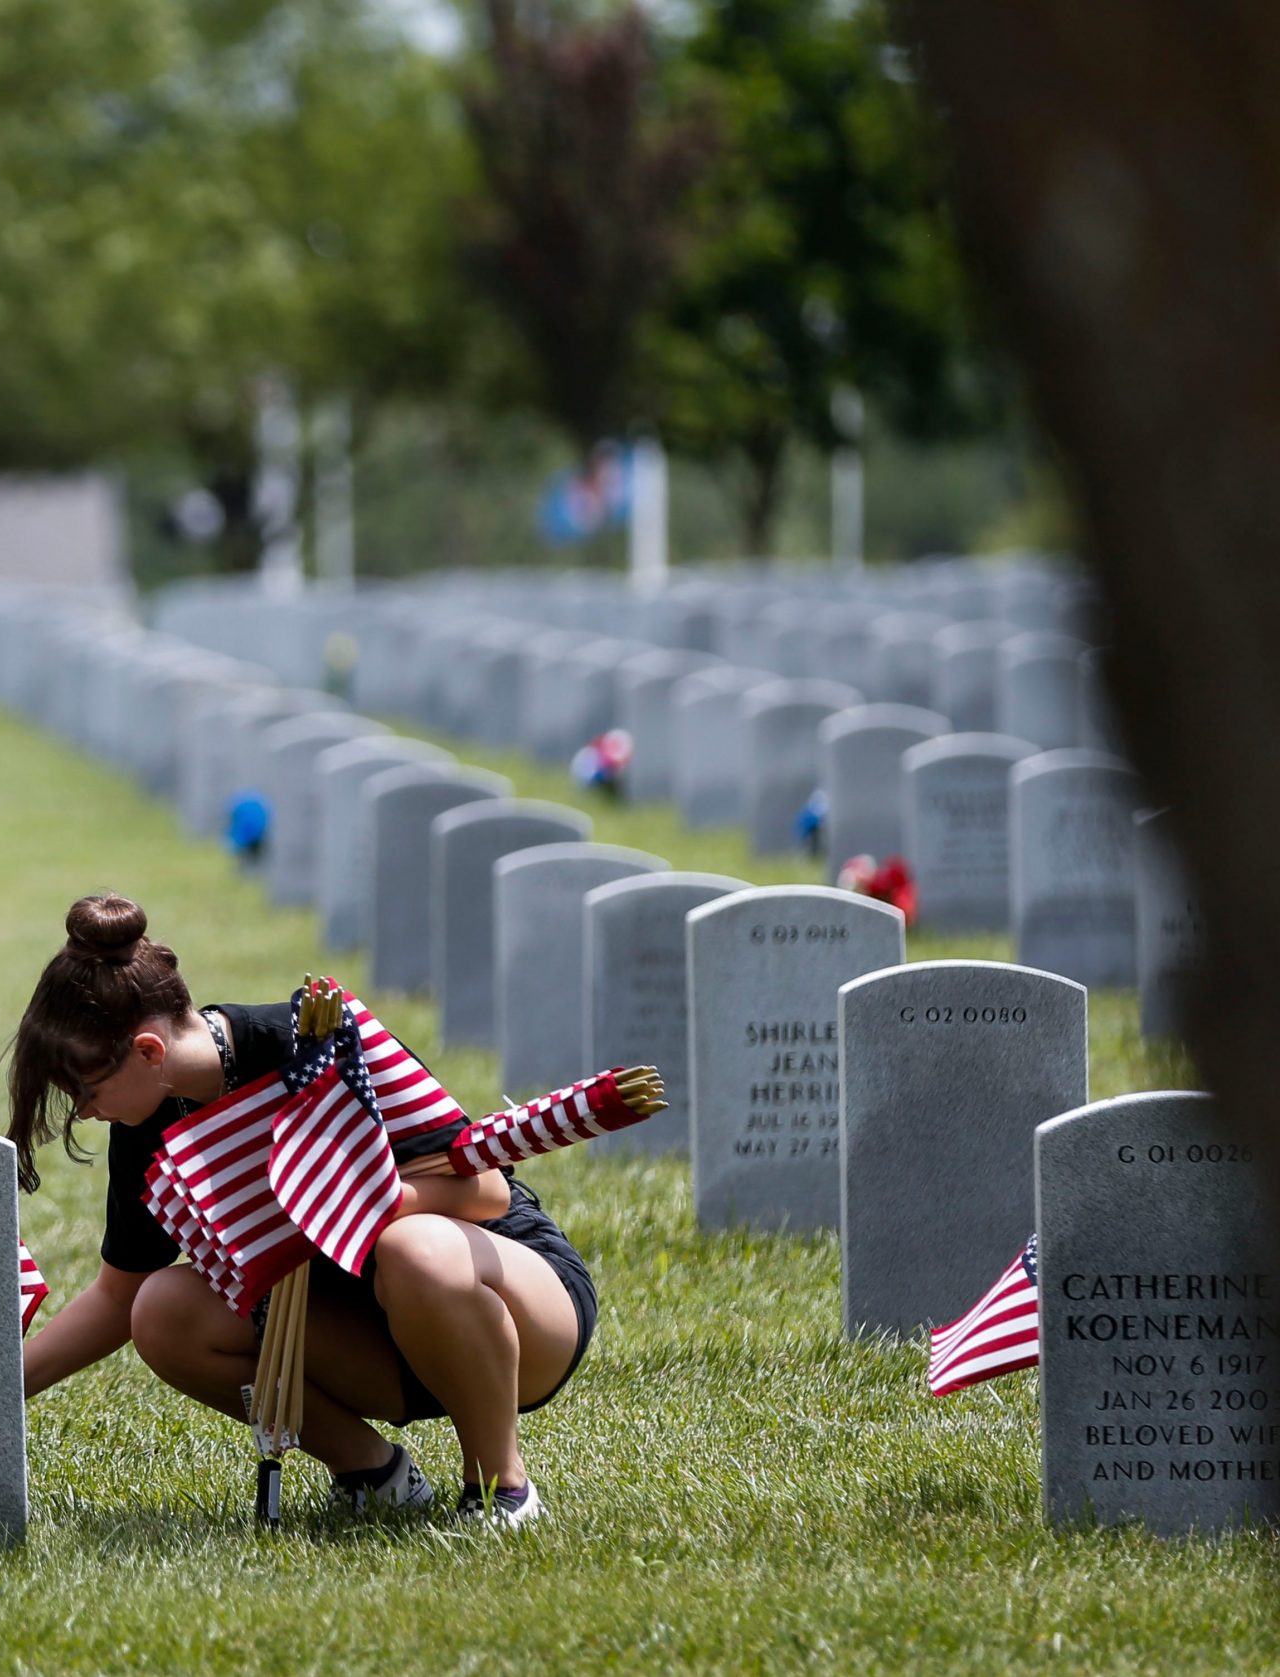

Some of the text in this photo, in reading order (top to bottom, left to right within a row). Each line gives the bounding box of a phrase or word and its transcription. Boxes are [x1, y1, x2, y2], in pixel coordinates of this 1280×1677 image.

[750, 924, 765, 945] G
[900, 1006, 1027, 1024] G 02 0080
[769, 1051, 838, 1074] JEAN
[733, 1137, 778, 1158] MAY
[1117, 1145, 1135, 1164] G
[1186, 1143, 1253, 1164] 0026
[1061, 1273, 1272, 1302] CATHERINE
[1113, 1354, 1266, 1376] NOV 6 1917
[1095, 1389, 1154, 1411] JAN
[1166, 1389, 1195, 1411] 26
[1086, 1425, 1214, 1446] BELOVED
[1093, 1460, 1155, 1481] AND
